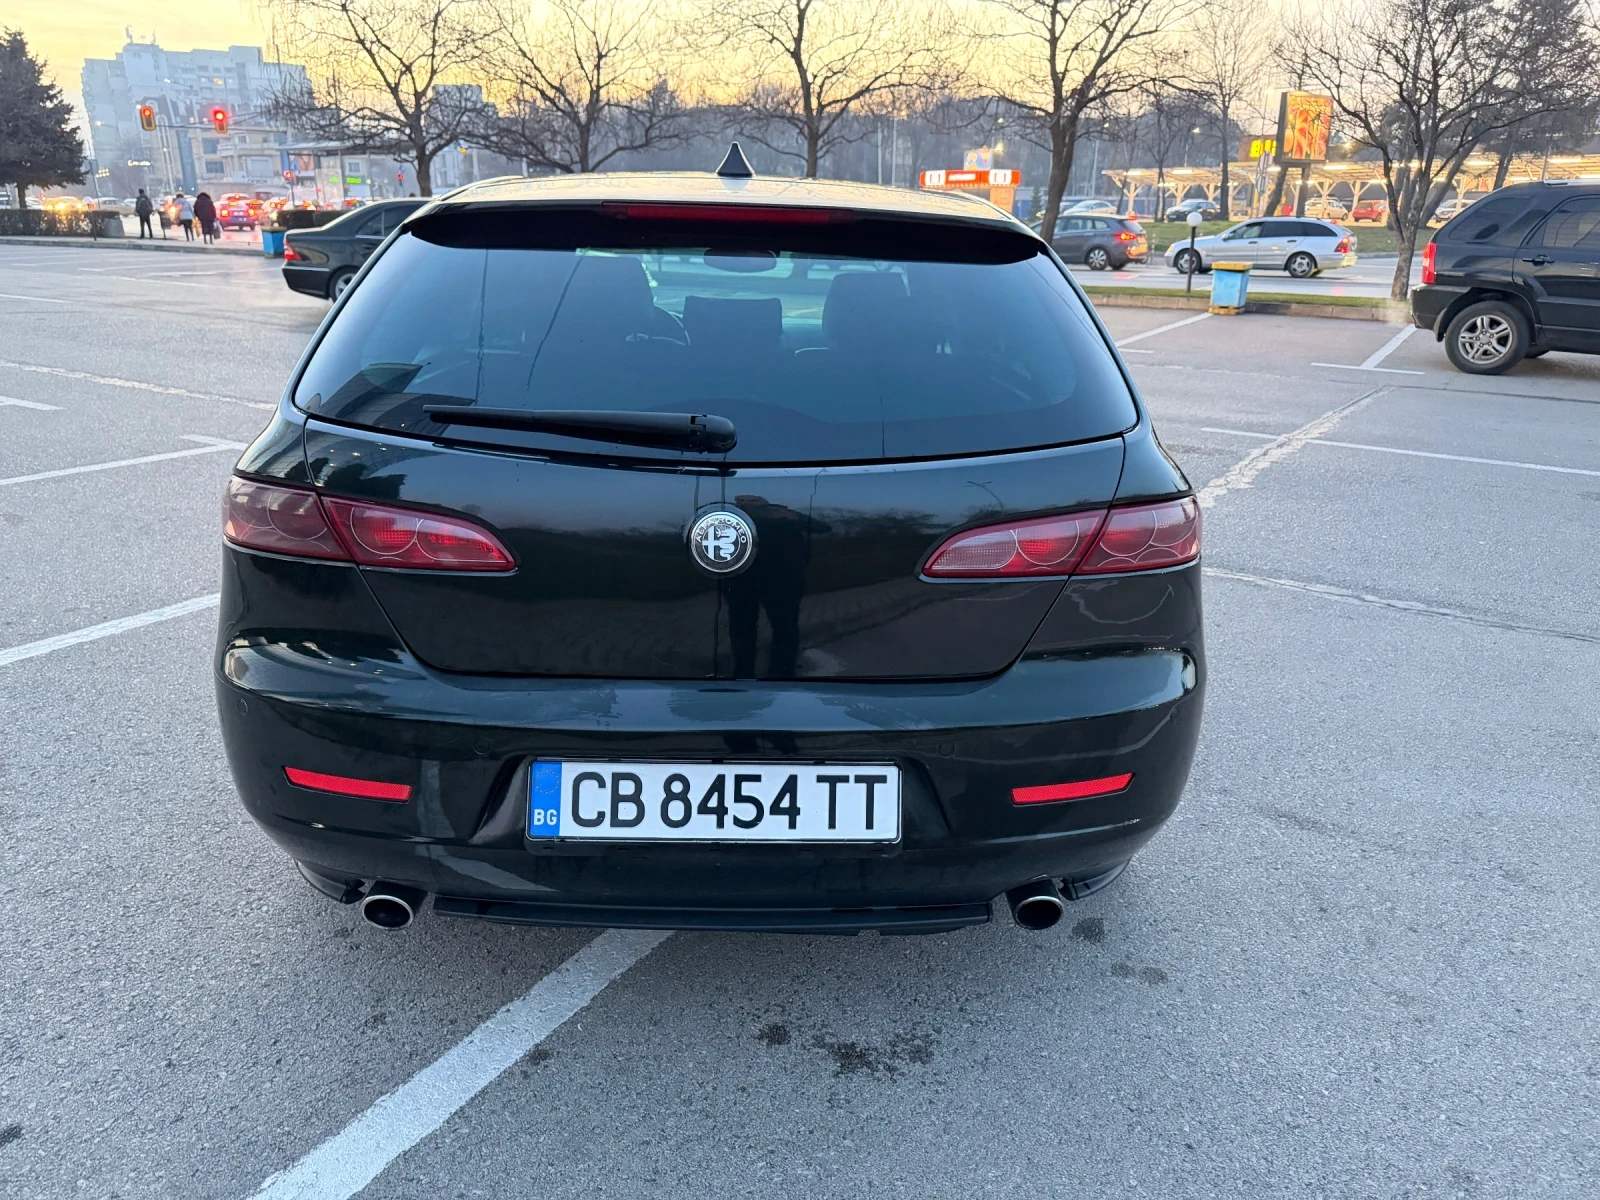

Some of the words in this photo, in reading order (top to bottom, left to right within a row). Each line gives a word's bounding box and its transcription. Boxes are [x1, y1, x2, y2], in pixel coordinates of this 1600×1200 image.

[533, 808, 558, 827] BG
[571, 771, 646, 829] CB
[660, 773, 801, 830] 8454
[816, 774, 888, 830] TT
